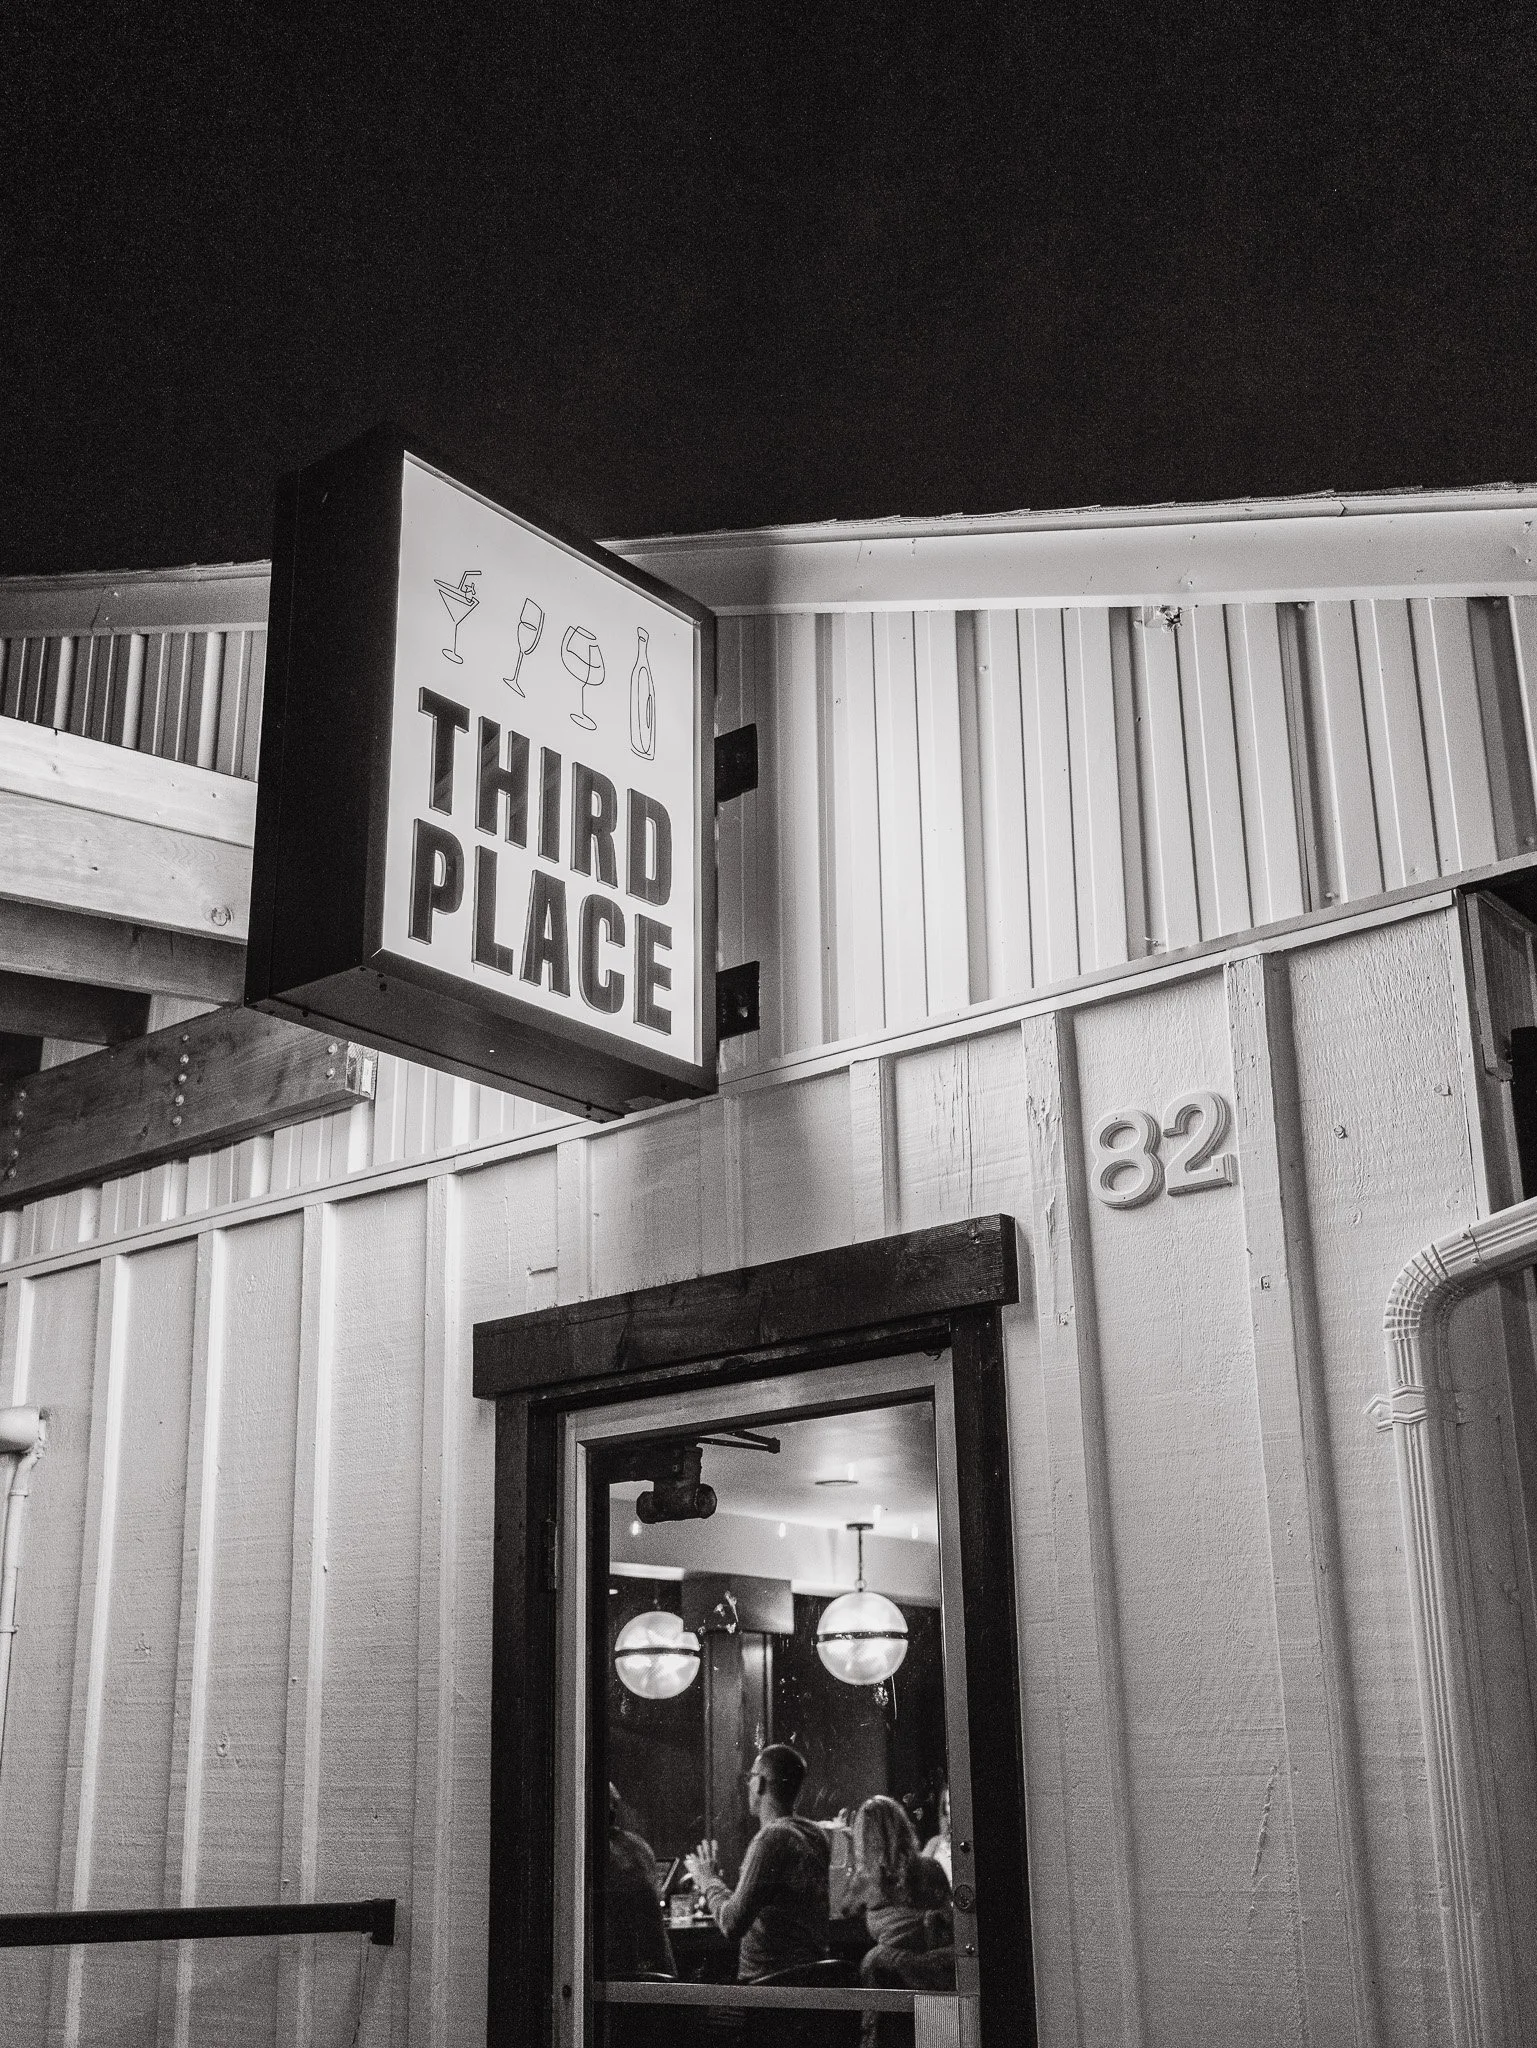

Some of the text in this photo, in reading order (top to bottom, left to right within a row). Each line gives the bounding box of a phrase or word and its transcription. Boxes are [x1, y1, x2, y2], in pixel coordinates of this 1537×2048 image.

[419, 687, 672, 906] THIRD
[408, 818, 672, 1036] PLACE
[1090, 1090, 1233, 1209] 82
